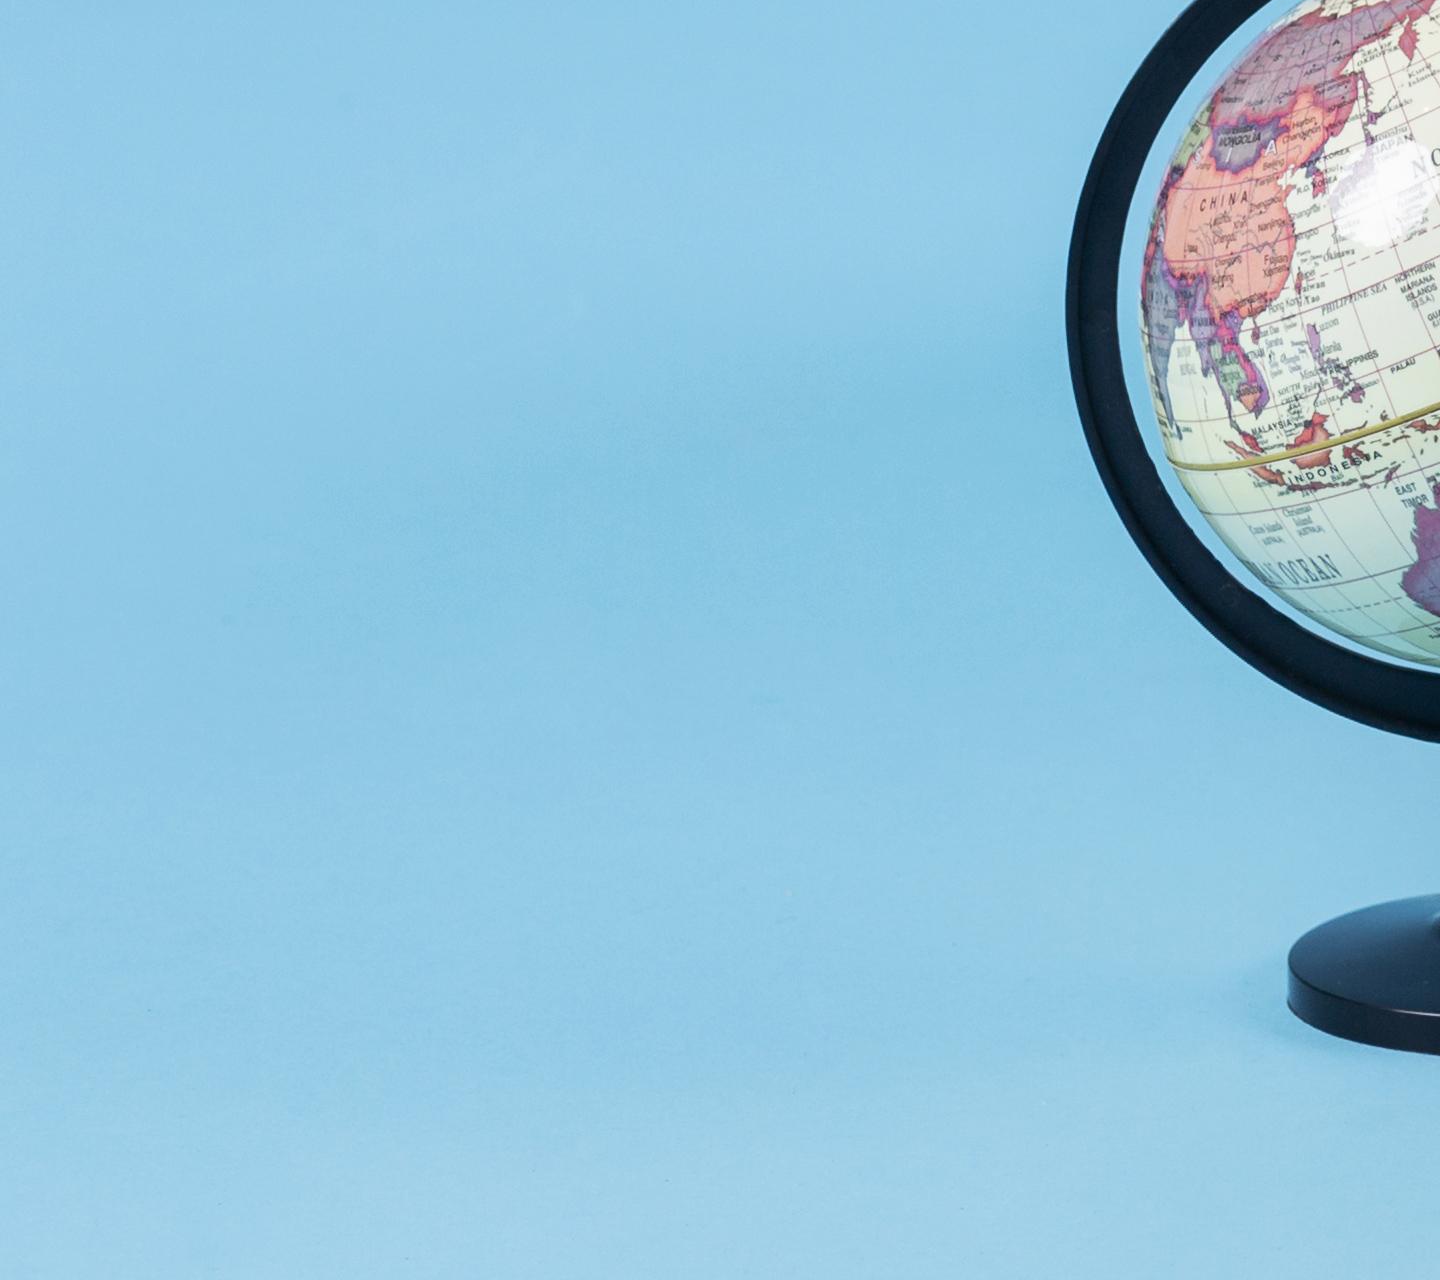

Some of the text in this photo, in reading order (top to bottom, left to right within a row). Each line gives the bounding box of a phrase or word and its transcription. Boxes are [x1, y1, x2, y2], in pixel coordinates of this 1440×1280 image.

[1373, 133, 1415, 156] JAPAN
[1199, 190, 1248, 212] CHINA
[1394, 261, 1436, 284] NORTHERN
[1400, 274, 1435, 294] MARIANA
[1405, 283, 1438, 302] ISLANDS
[1320, 282, 1388, 317] PHILIPPINE SEA
[1390, 357, 1417, 374] PALAU
[1251, 418, 1292, 436] MALAYSIA
[1287, 449, 1383, 486] INDONESIA
[1394, 482, 1417, 496] EAST
[1401, 493, 1431, 510] TIMOR
[1276, 553, 1344, 587] OCEAN
